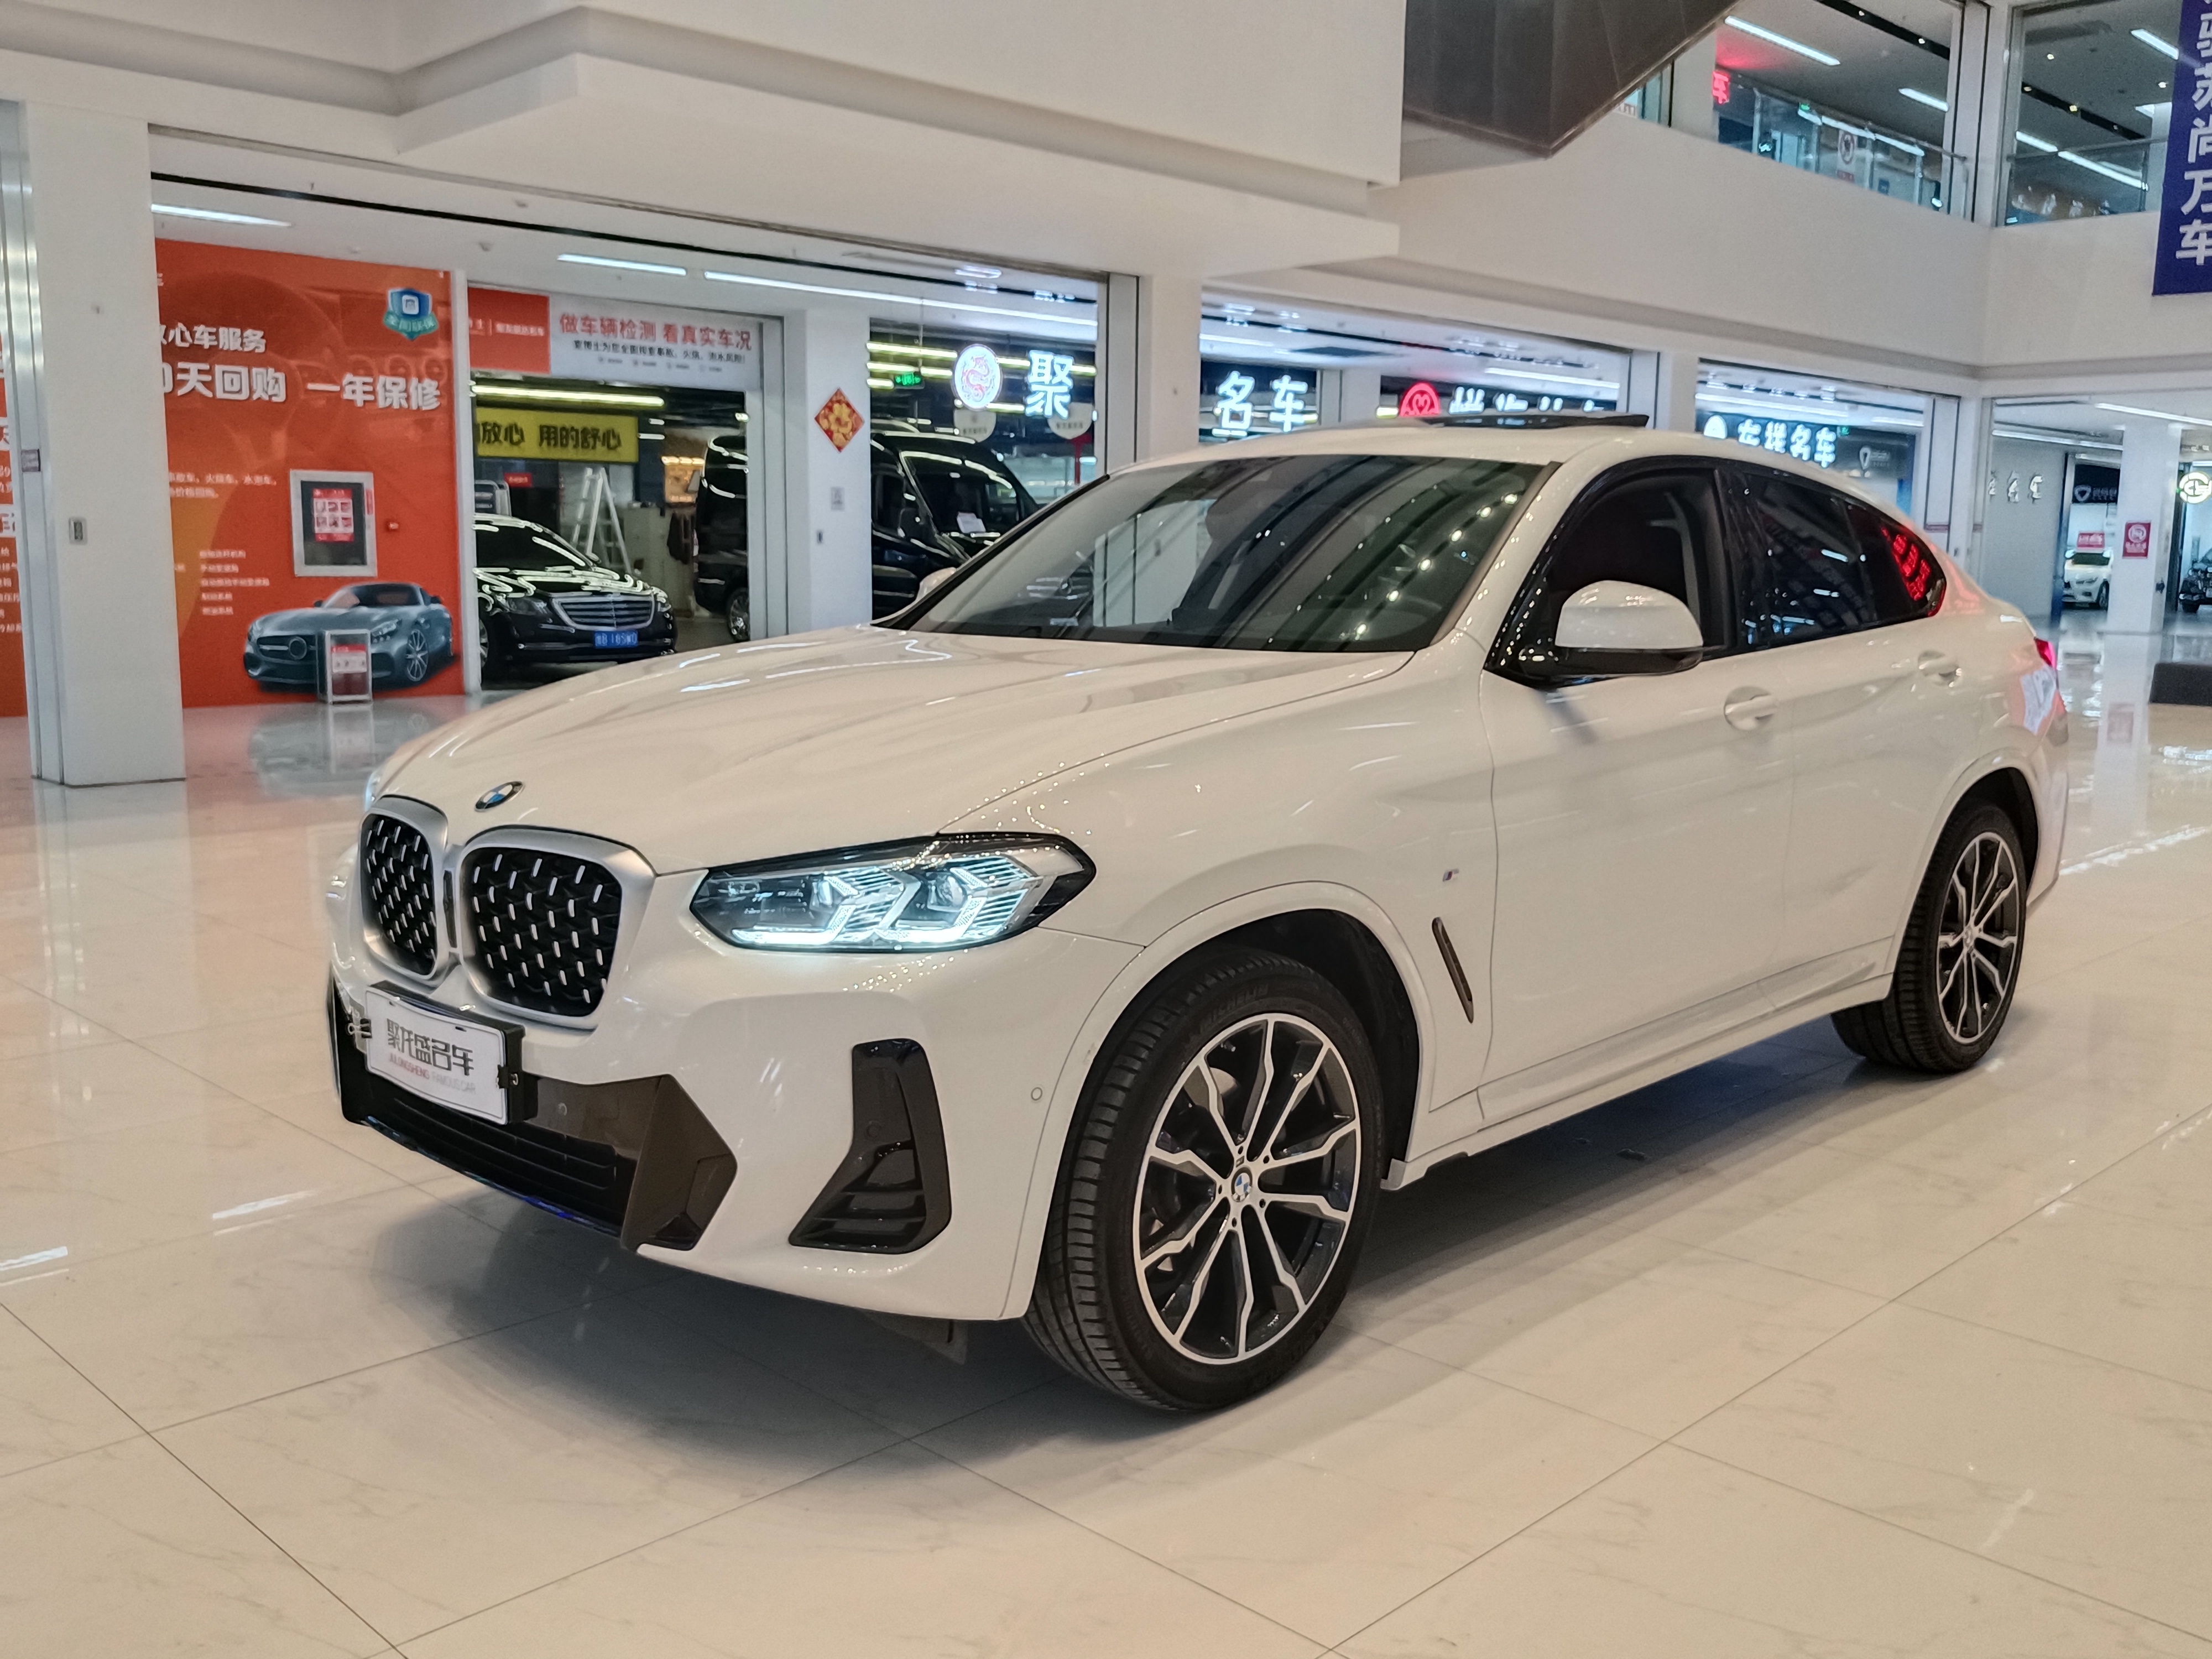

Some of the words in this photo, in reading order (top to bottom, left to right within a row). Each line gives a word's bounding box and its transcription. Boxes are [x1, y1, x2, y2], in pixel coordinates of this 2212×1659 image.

[2176, 0, 2212, 265] 尚万车
[559, 312, 656, 342] 做车辆检测
[664, 322, 752, 351] 看真实车况
[307, 372, 441, 411] 一年保修
[1025, 349, 1074, 419] 聚
[1215, 370, 1308, 433] 名车
[539, 424, 623, 450] 用的舒心
[387, 1018, 474, 1076] 聚龙盛名车
